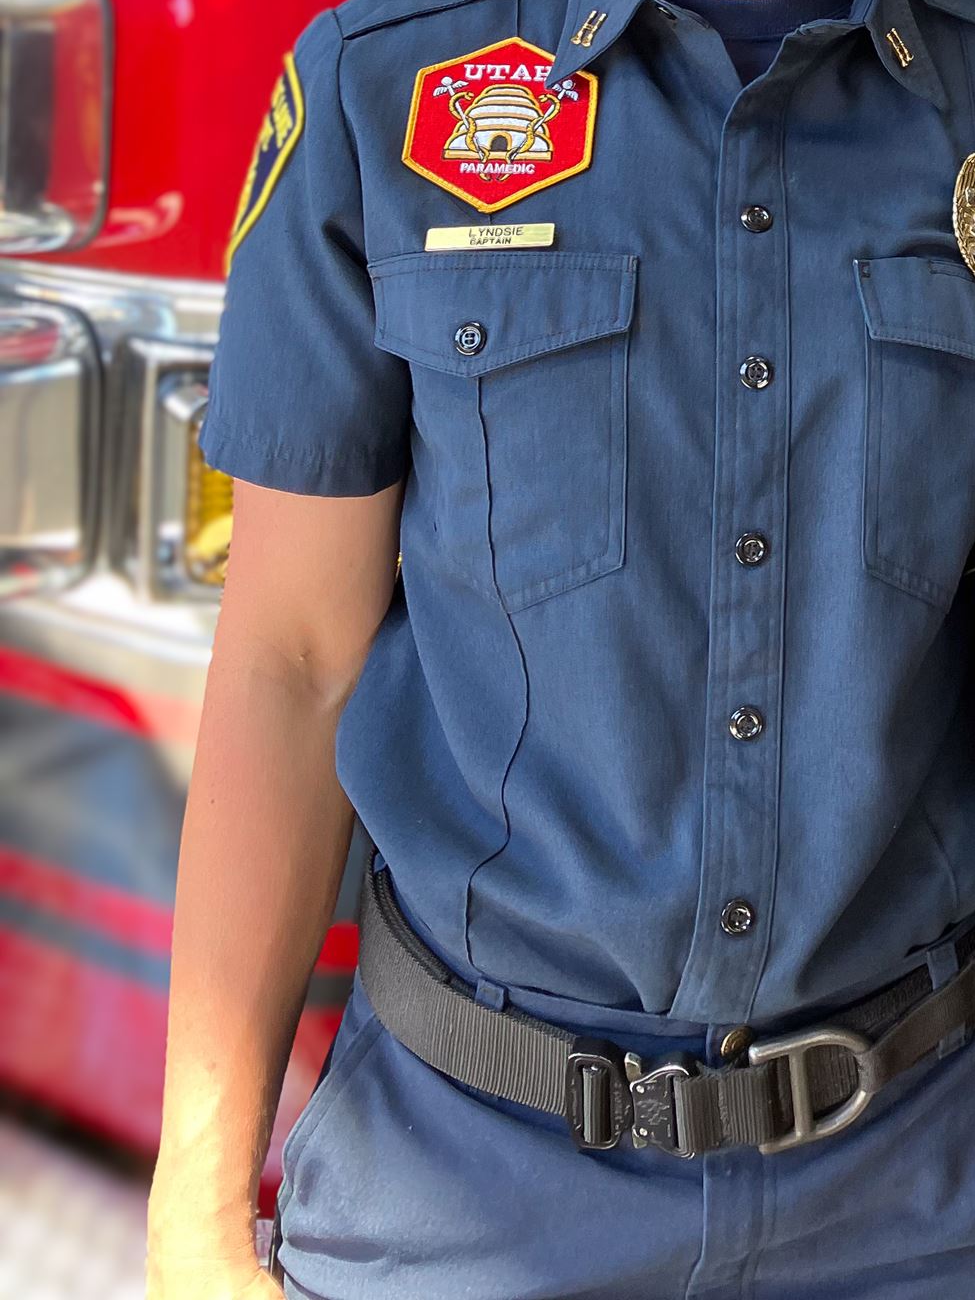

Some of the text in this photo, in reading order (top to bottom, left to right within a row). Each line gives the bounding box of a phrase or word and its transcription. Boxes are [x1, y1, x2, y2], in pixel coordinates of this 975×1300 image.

[463, 63, 553, 82] UTAH
[460, 162, 536, 175] PARAMEDIC
[468, 226, 524, 238] LYNDSIE
[469, 237, 512, 246] CAPTAIN
